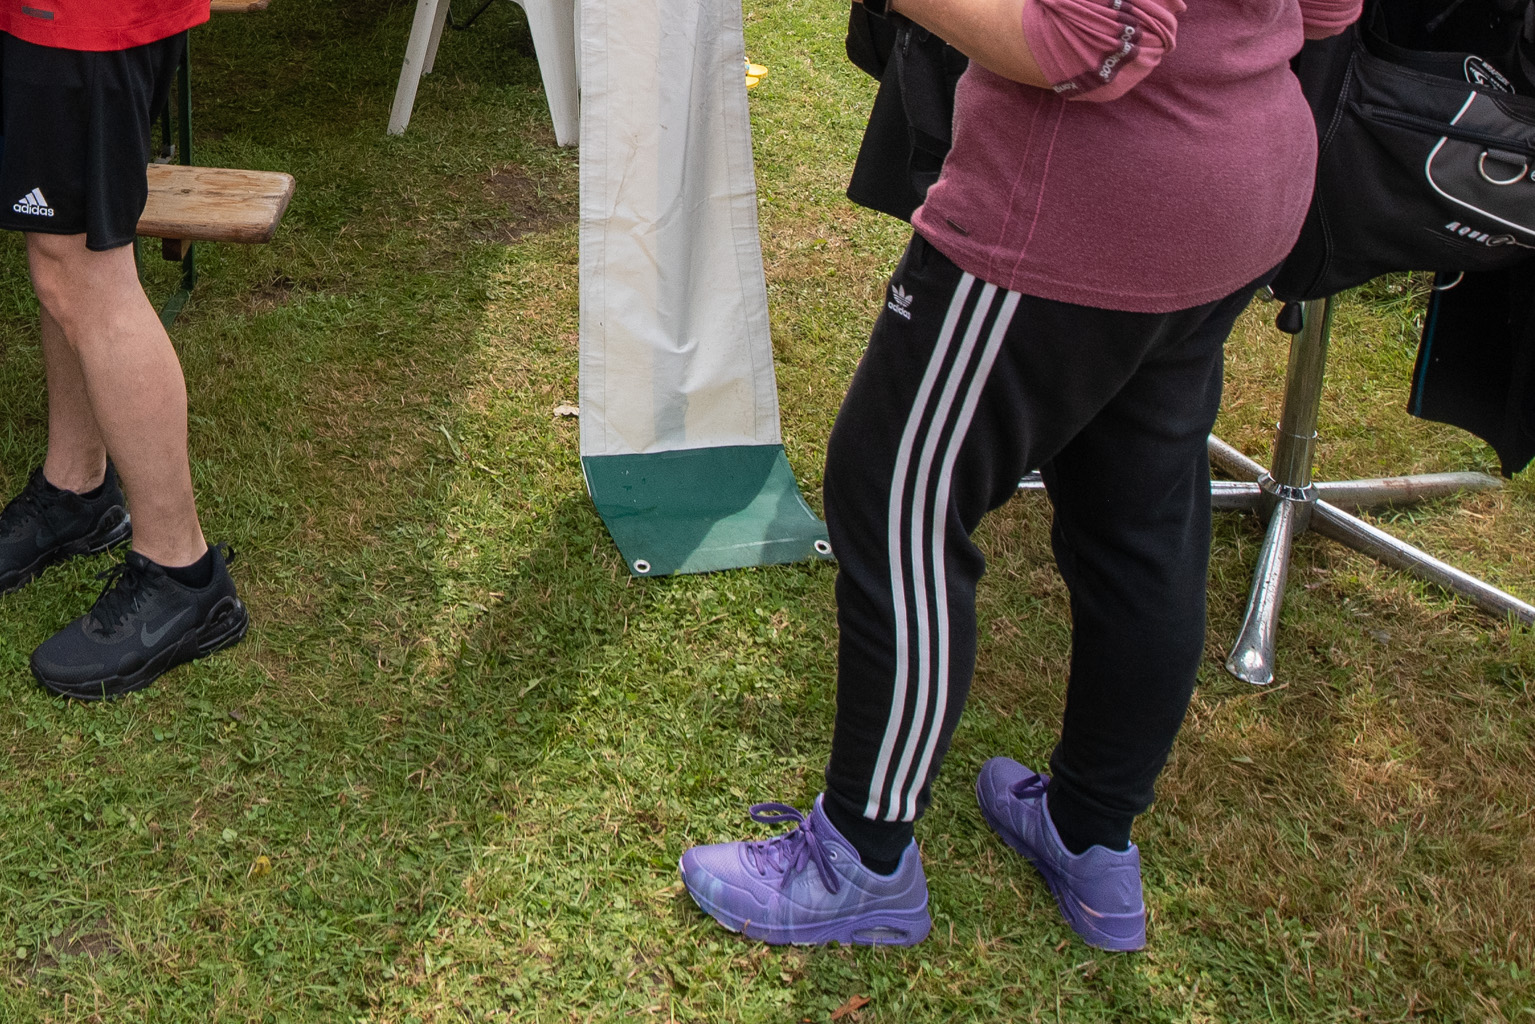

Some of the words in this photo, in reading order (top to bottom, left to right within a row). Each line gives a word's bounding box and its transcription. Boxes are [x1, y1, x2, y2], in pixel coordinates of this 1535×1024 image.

[13, 203, 54, 216] adidas
[1445, 221, 1489, 242] AQUA
[888, 301, 911, 320] adidas
